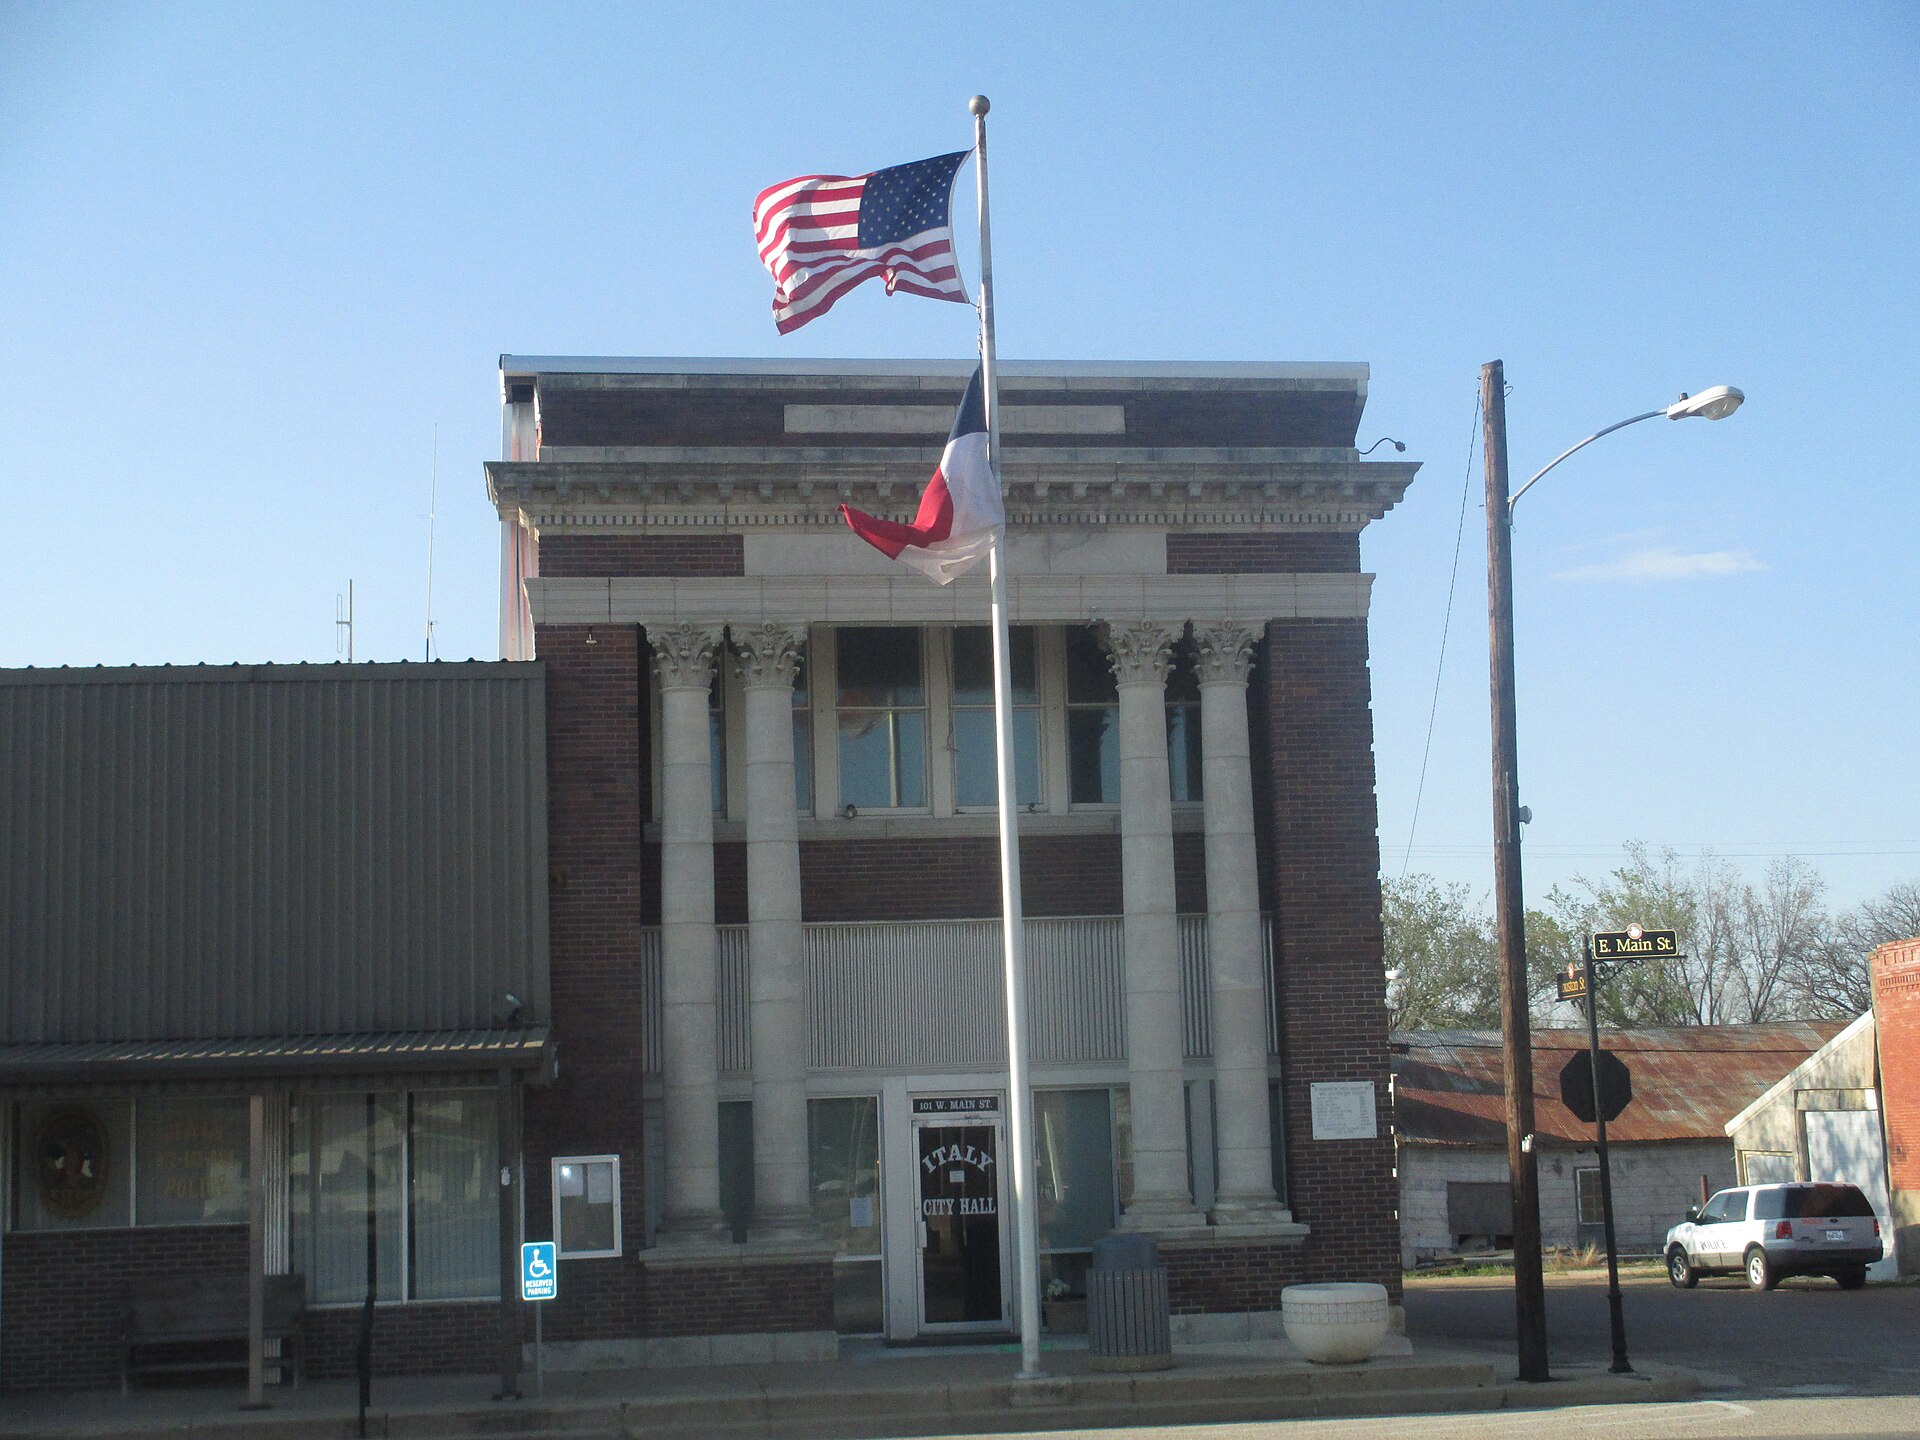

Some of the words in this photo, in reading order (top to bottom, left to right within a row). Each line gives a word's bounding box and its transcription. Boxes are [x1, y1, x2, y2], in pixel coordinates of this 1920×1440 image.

[1598, 939, 1611, 953] E.
[1616, 938, 1652, 952] Main
[1656, 936, 1674, 951] St.
[920, 1102, 932, 1111] 101
[935, 1101, 947, 1110] W.
[950, 1100, 976, 1110] MAIN
[978, 1099, 993, 1109] ST.
[921, 1143, 994, 1174] ITALY
[923, 1198, 955, 1216] CITY
[959, 1197, 996, 1215] HALL
[1700, 1238, 1729, 1250] POLICE
[525, 1279, 553, 1288] RESERVED
[527, 1287, 552, 1296] PARKING
